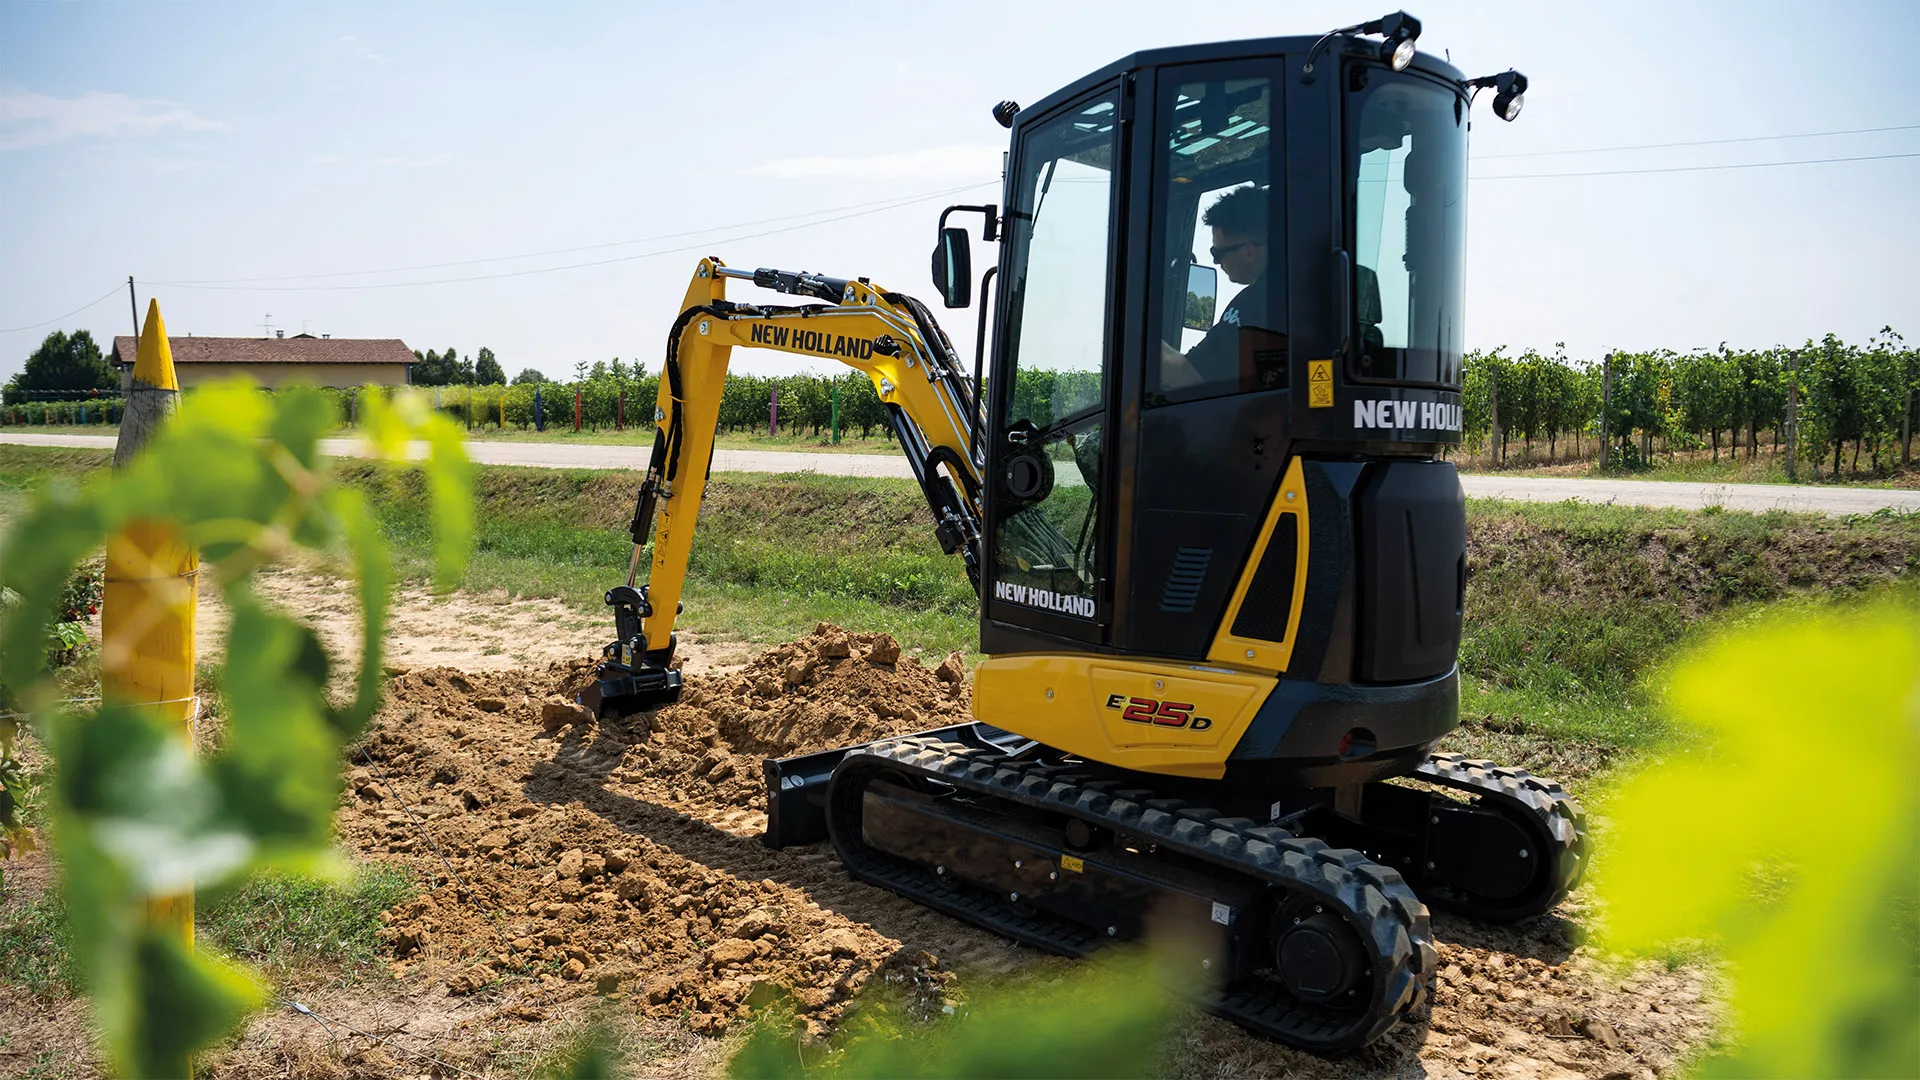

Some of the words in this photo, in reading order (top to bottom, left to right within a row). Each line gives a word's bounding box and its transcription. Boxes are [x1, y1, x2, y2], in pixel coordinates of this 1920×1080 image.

[751, 323, 789, 346] NEW
[791, 329, 873, 360] HOLLAND
[1354, 400, 1417, 428] NEW
[995, 580, 1026, 603] NEW
[1028, 587, 1095, 618] HOLLAND
